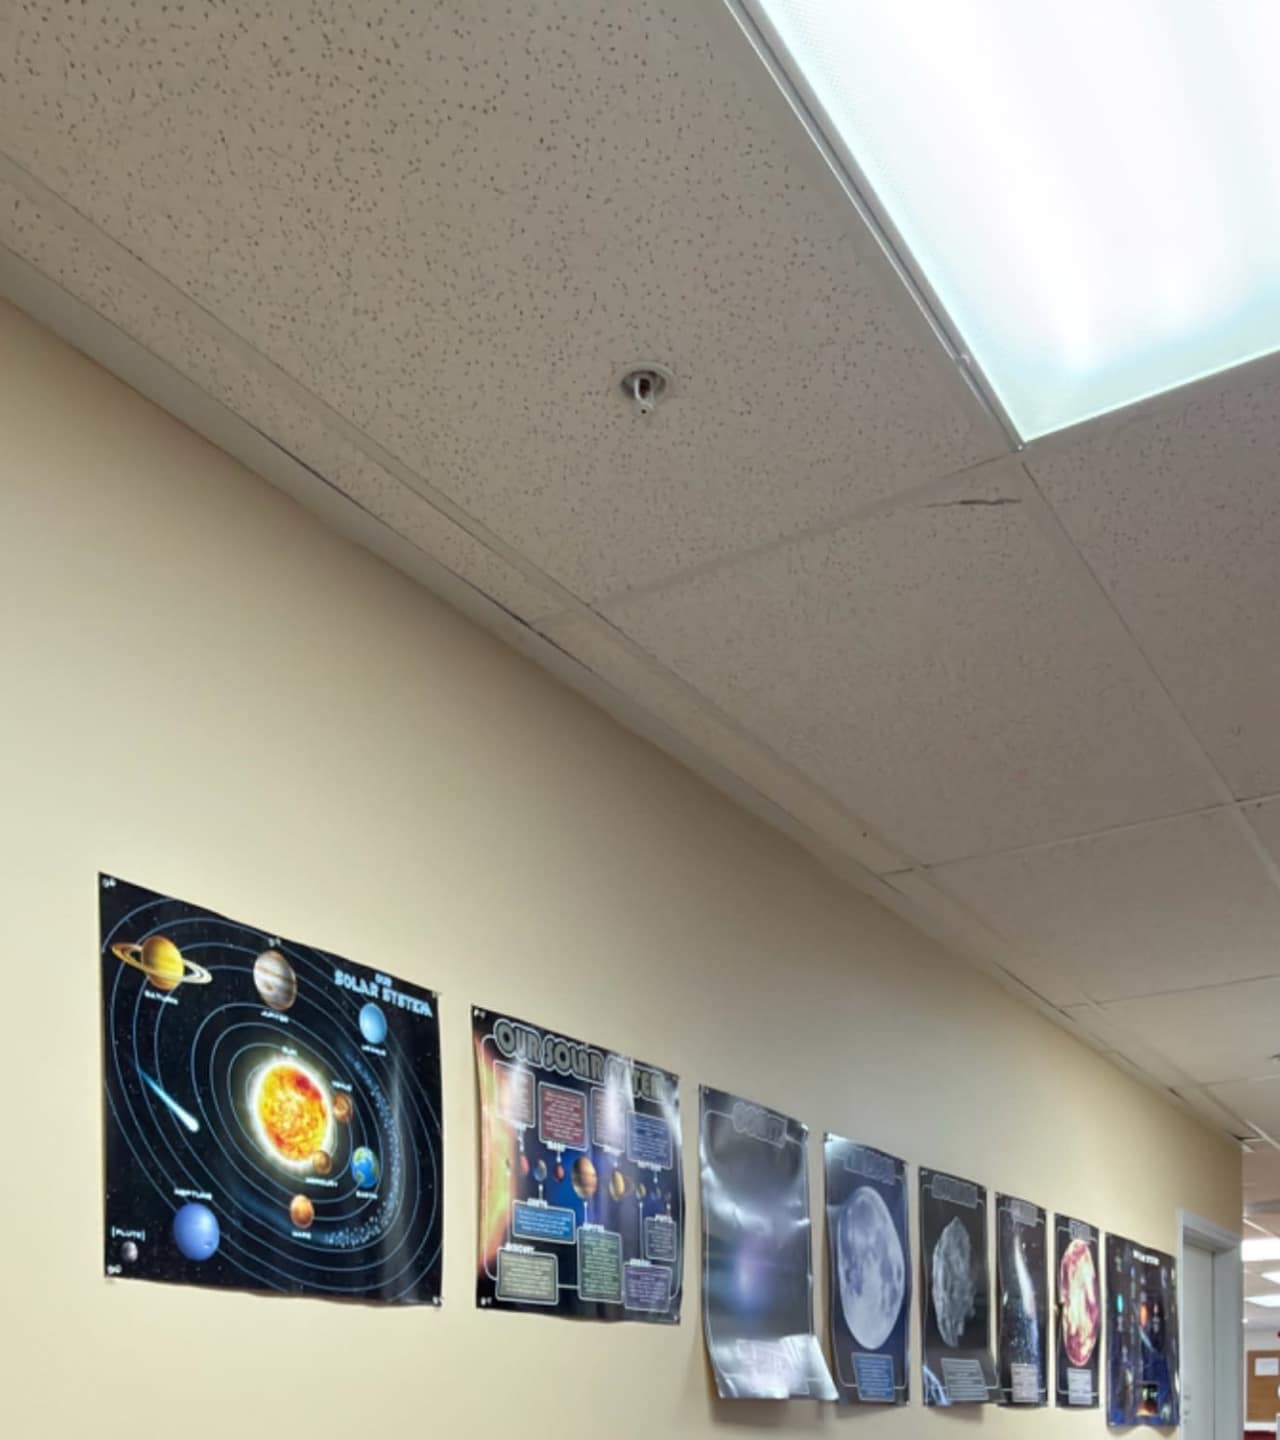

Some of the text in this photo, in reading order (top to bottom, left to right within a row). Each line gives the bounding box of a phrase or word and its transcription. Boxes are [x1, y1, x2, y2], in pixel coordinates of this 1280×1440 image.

[334, 969, 433, 1017] SOLAR SYSTEM
[497, 1020, 541, 1062] OUR
[544, 1036, 603, 1080] SOLAR
